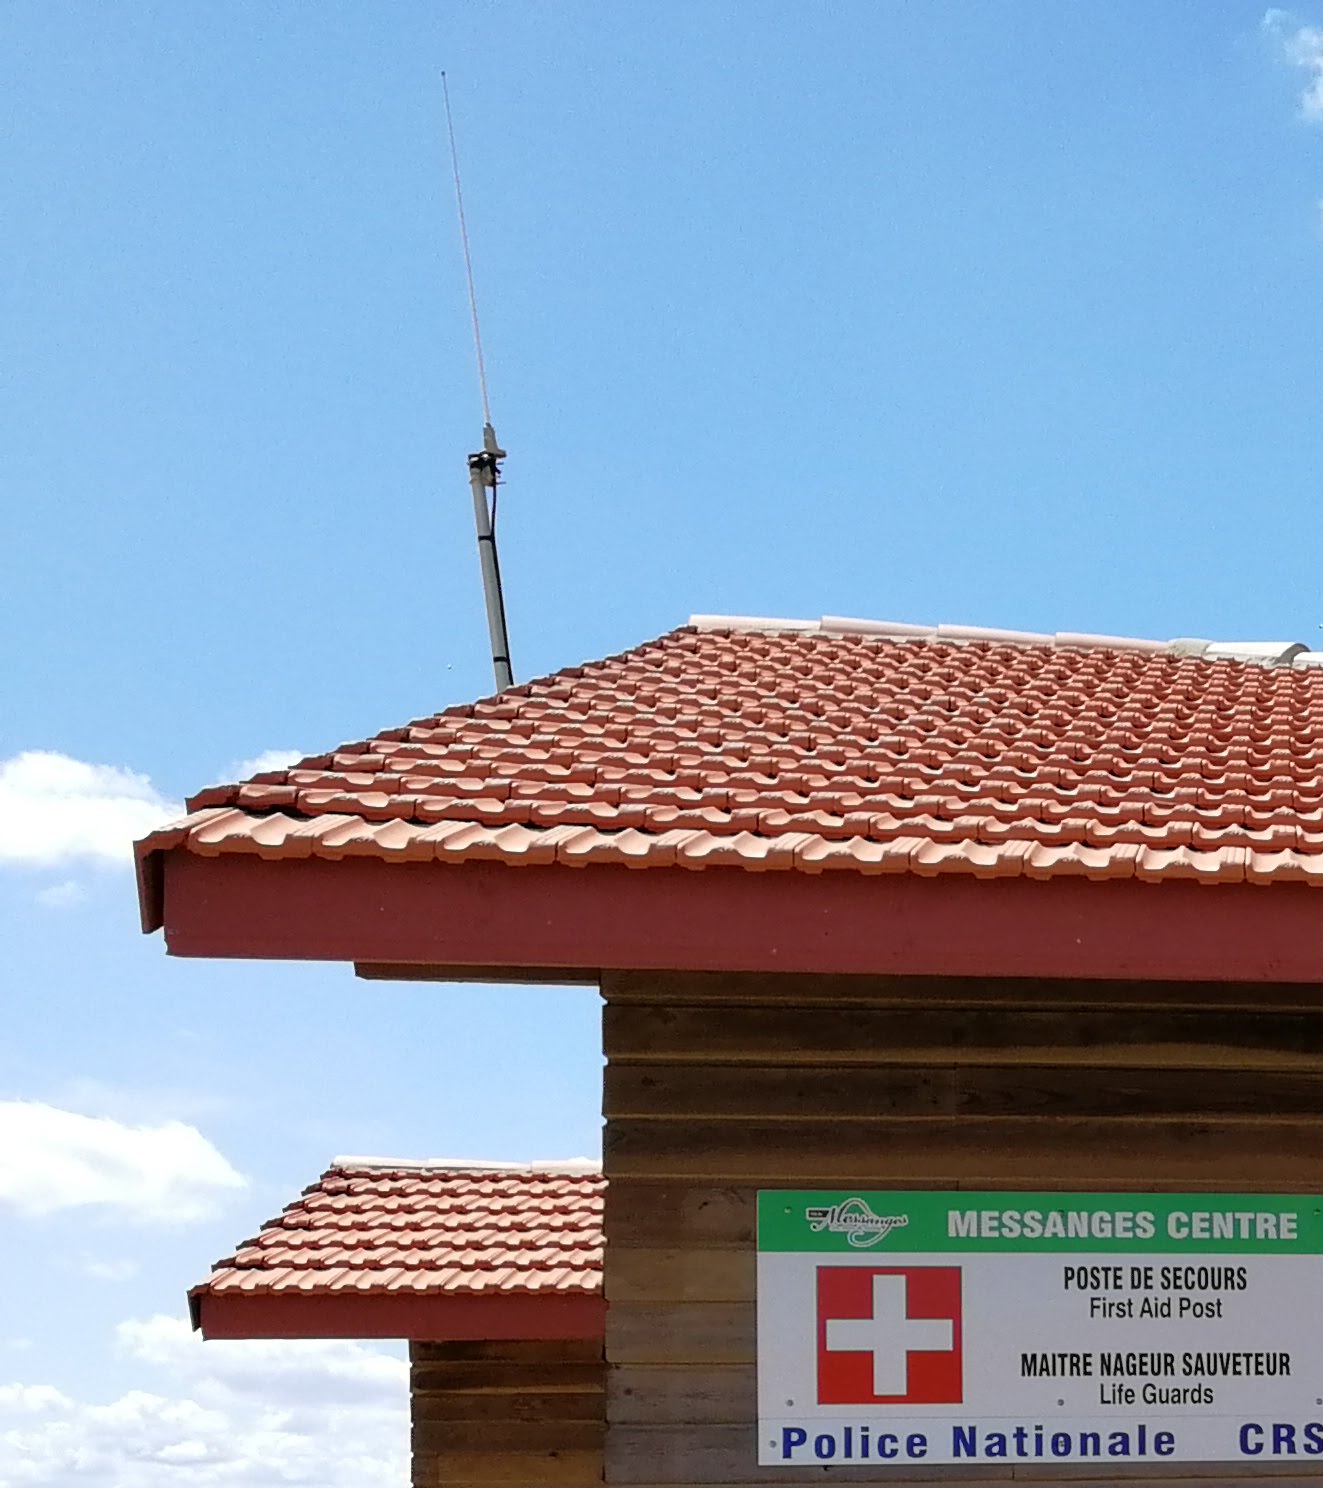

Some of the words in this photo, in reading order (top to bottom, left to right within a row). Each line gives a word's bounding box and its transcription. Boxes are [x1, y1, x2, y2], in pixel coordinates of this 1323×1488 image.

[948, 1210, 1155, 1239] MESSANGES
[1167, 1211, 1298, 1239] CENTRE
[1064, 1266, 1123, 1290] POSTE
[1131, 1266, 1153, 1290] DE
[1160, 1266, 1247, 1290] SECOURS
[1090, 1297, 1134, 1318] First
[1139, 1297, 1171, 1318] Aid
[1179, 1298, 1223, 1318] Post
[1021, 1352, 1092, 1376] MAITRE
[1100, 1352, 1175, 1376] NAGEUR
[1182, 1352, 1291, 1376] SAUVETEUR
[1100, 1382, 1135, 1405] Life
[1143, 1382, 1214, 1405] Guards
[782, 1425, 928, 1459] Police
[952, 1424, 1176, 1458] Nationale
